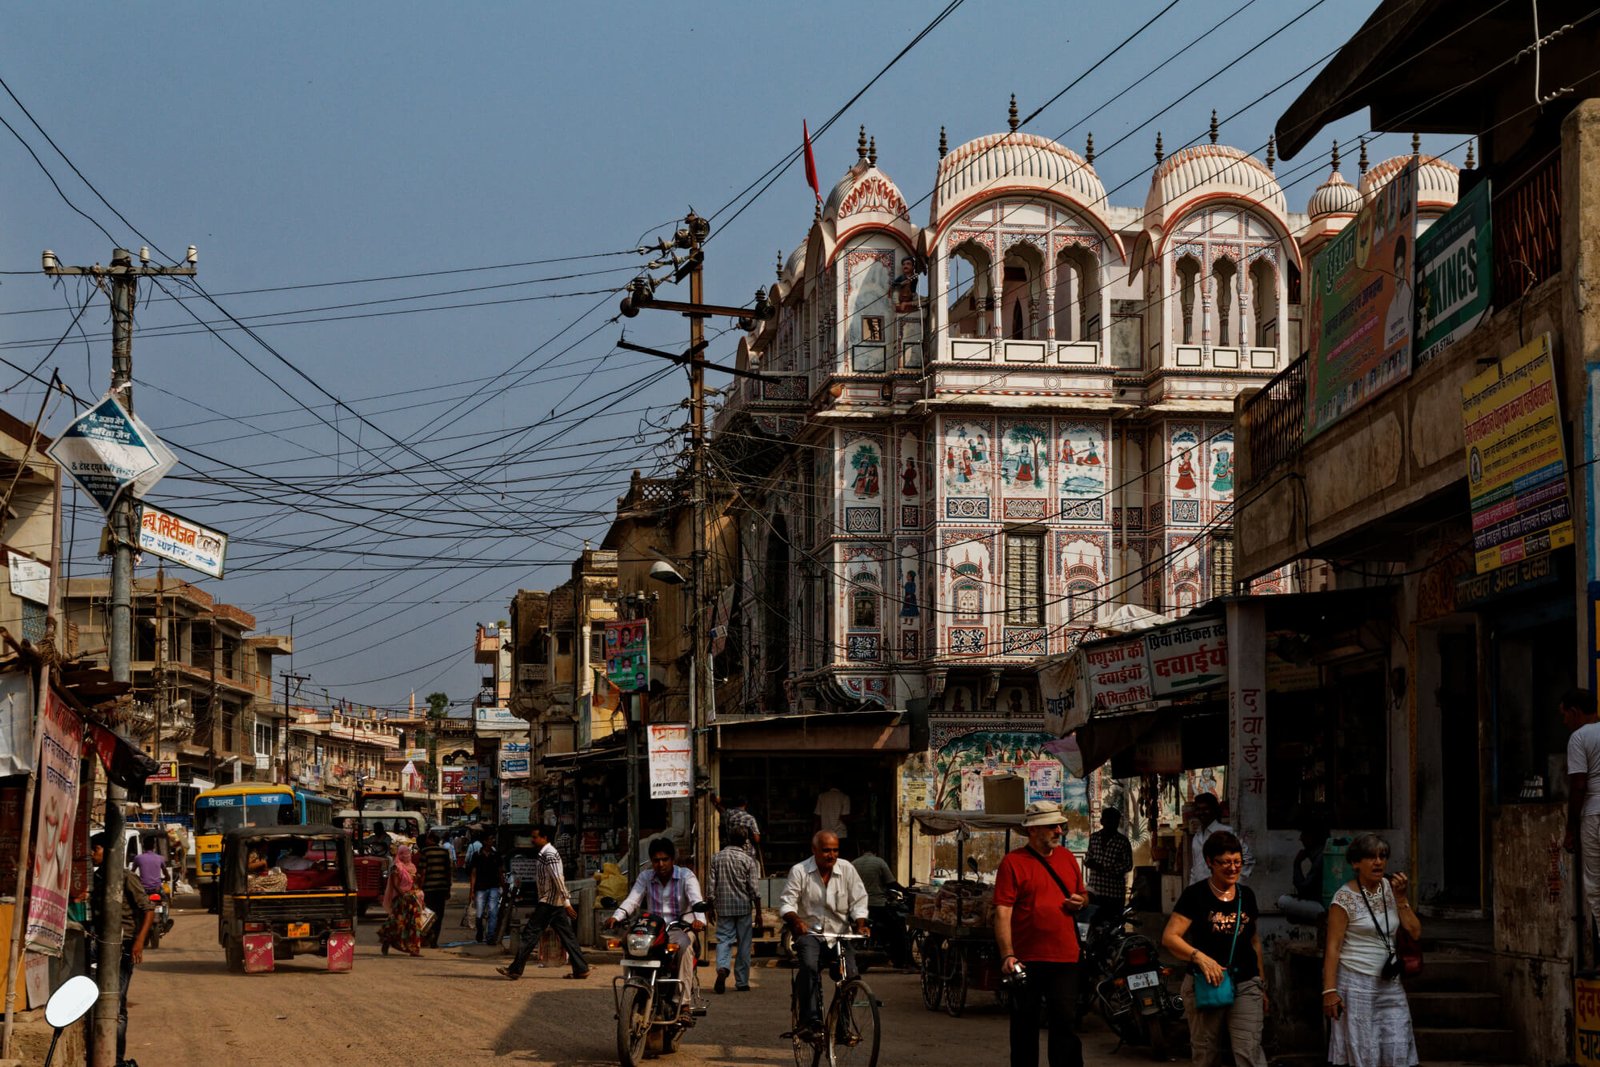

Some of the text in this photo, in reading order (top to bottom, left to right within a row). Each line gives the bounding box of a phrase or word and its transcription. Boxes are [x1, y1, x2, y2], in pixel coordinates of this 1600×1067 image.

[1432, 238, 1477, 318] KINGS
[1440, 332, 1455, 351] STALL
[142, 511, 157, 533] न्यू
[158, 513, 198, 548] सिटीजन
[1493, 562, 1521, 594] आटा
[1127, 640, 1145, 659] की
[1148, 633, 1172, 651] प्रिया
[1173, 625, 1212, 645] मेडिकल
[1107, 686, 1138, 706] मिलती
[208, 795, 279, 807] विद्यालय वाहन
